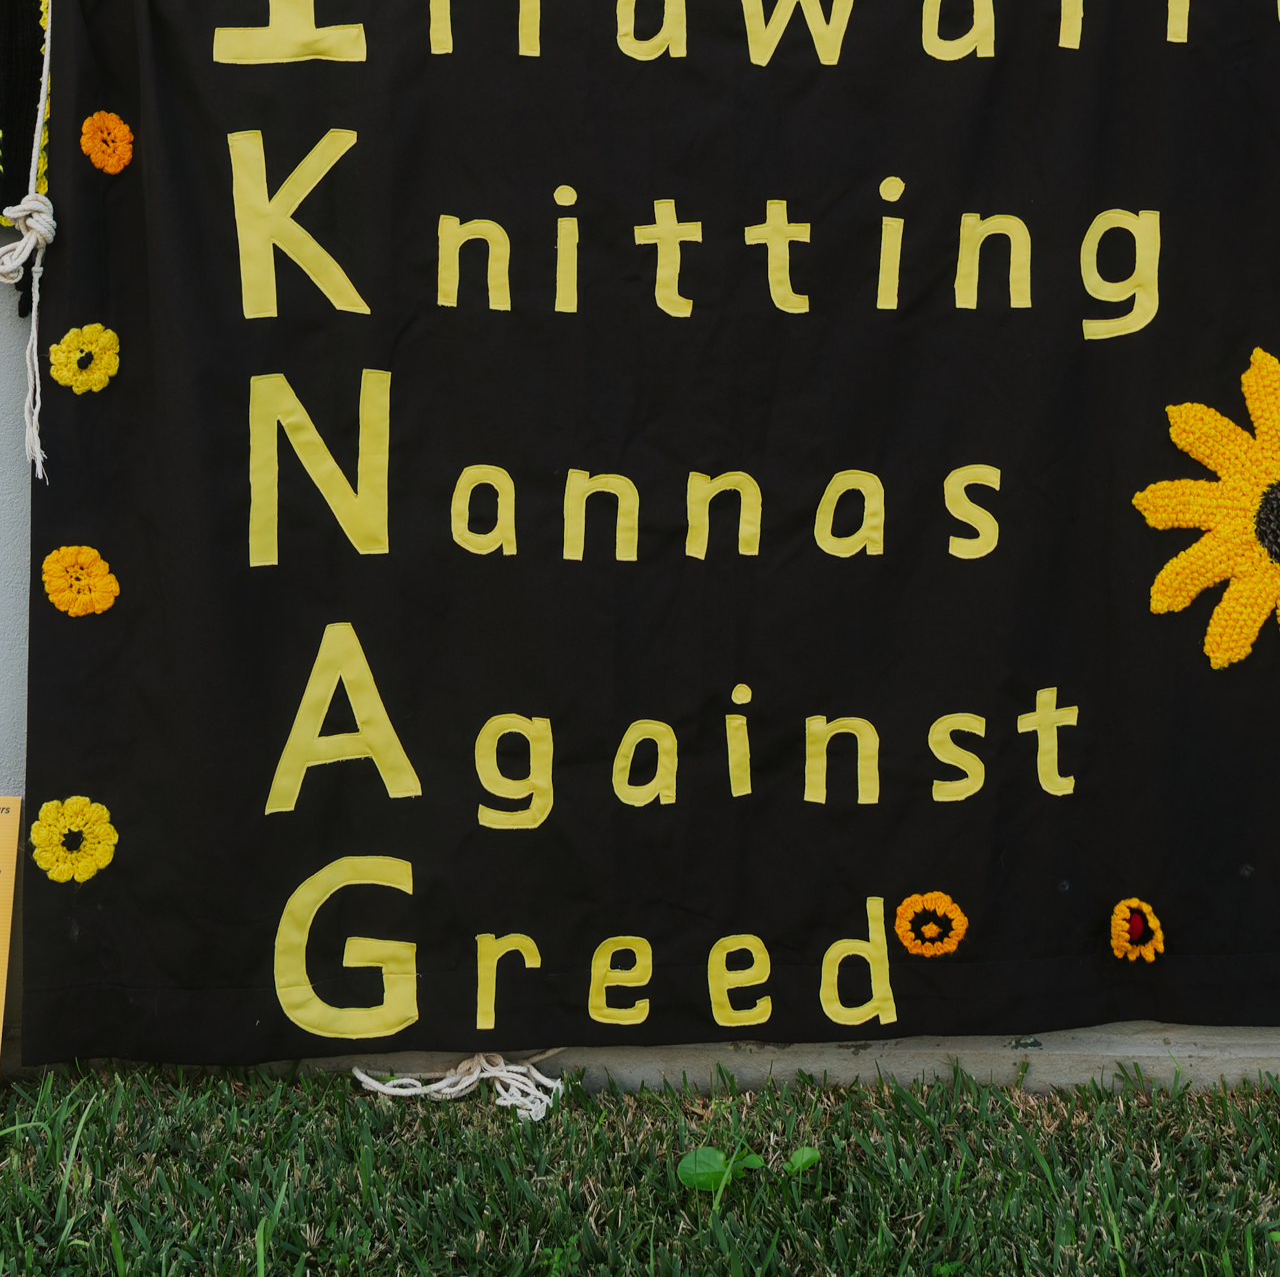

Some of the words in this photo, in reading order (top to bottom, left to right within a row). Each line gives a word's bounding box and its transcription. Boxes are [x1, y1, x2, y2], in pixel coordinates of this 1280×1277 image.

[228, 129, 1160, 340] Knitting
[249, 369, 1000, 567] Nannas
[265, 623, 1079, 829] Against
[274, 856, 898, 1039] Greed
